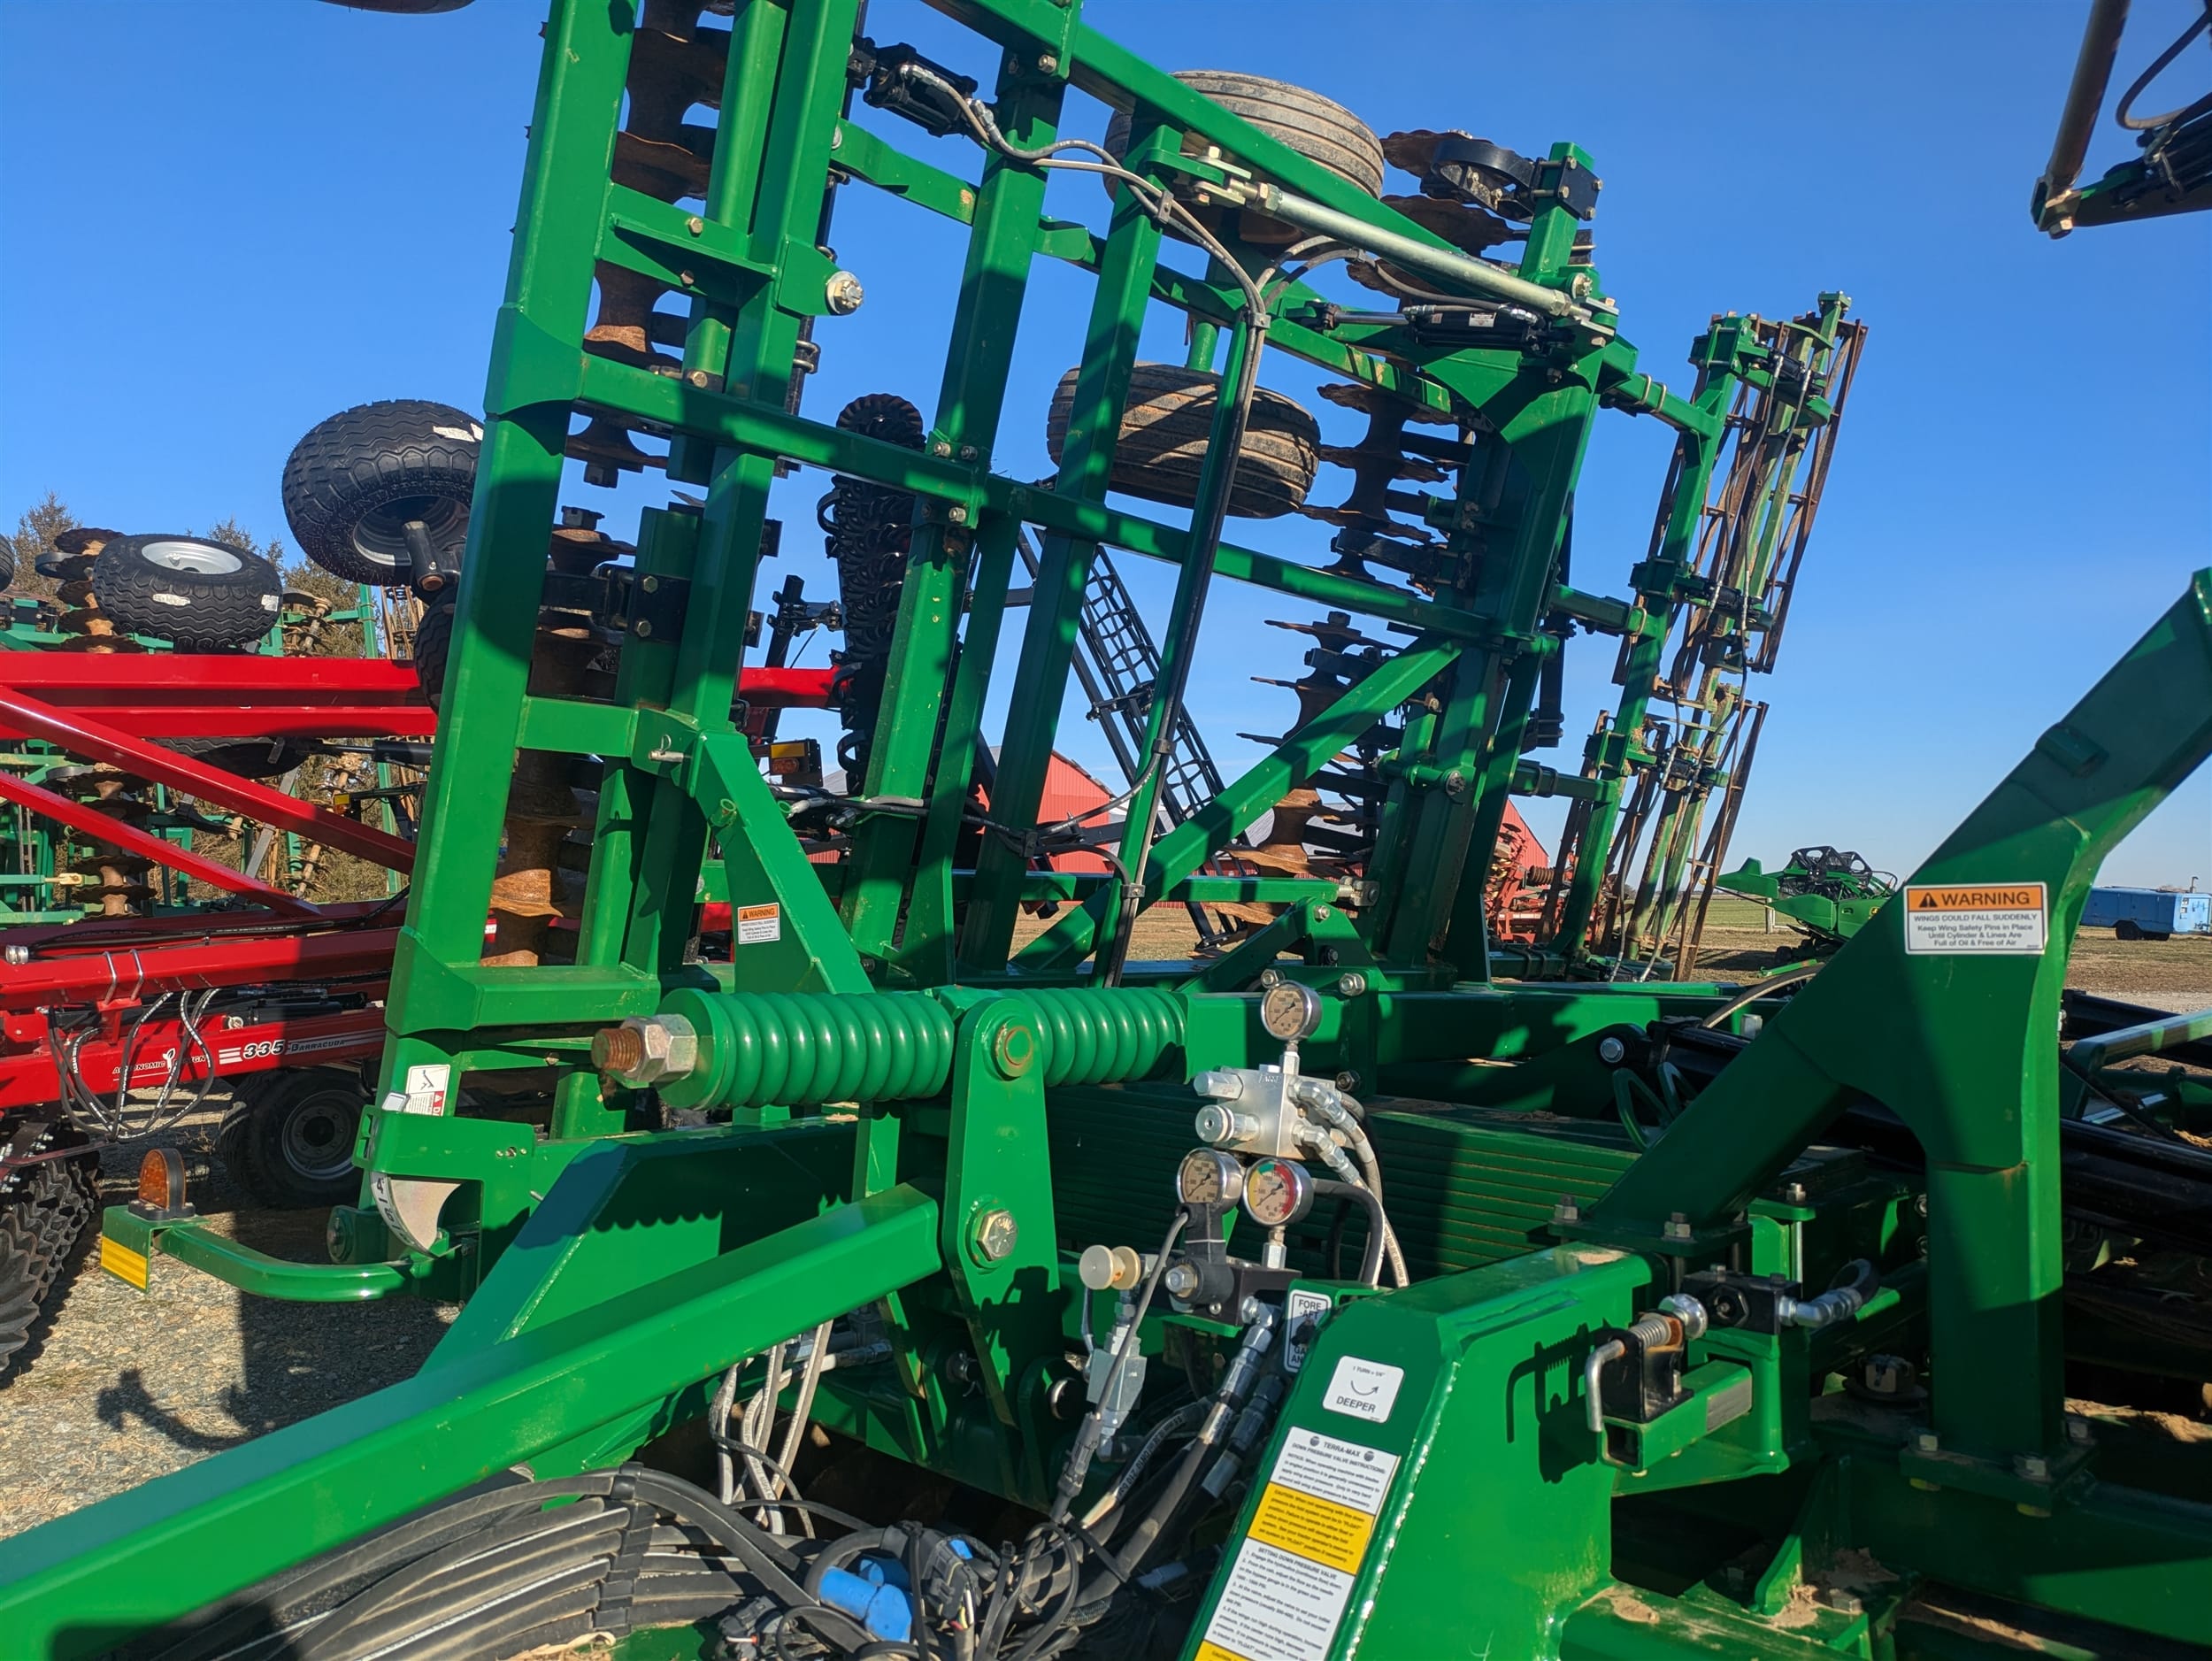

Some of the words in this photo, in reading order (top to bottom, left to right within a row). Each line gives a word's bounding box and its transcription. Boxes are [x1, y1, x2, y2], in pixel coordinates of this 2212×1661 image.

[1941, 892, 2030, 905] WARNING
[749, 908, 774, 918] WARNING
[243, 1040, 285, 1059] 335
[1298, 1299, 1322, 1311] FORE
[1300, 1310, 1318, 1319] -AFT
[1336, 1396, 1376, 1412] DEEPER
[1290, 1442, 1307, 1452] DOWN
[1306, 1447, 1333, 1459] PRESSURE
[1332, 1454, 1349, 1464] VALVE
[1322, 1441, 1362, 1457] TERRA-MAX
[1257, 1546, 1279, 1558] SETTING
[1277, 1553, 1294, 1565] DOWN
[1293, 1559, 1320, 1573] PRESSURE
[1319, 1569, 1338, 1580] VALVE
